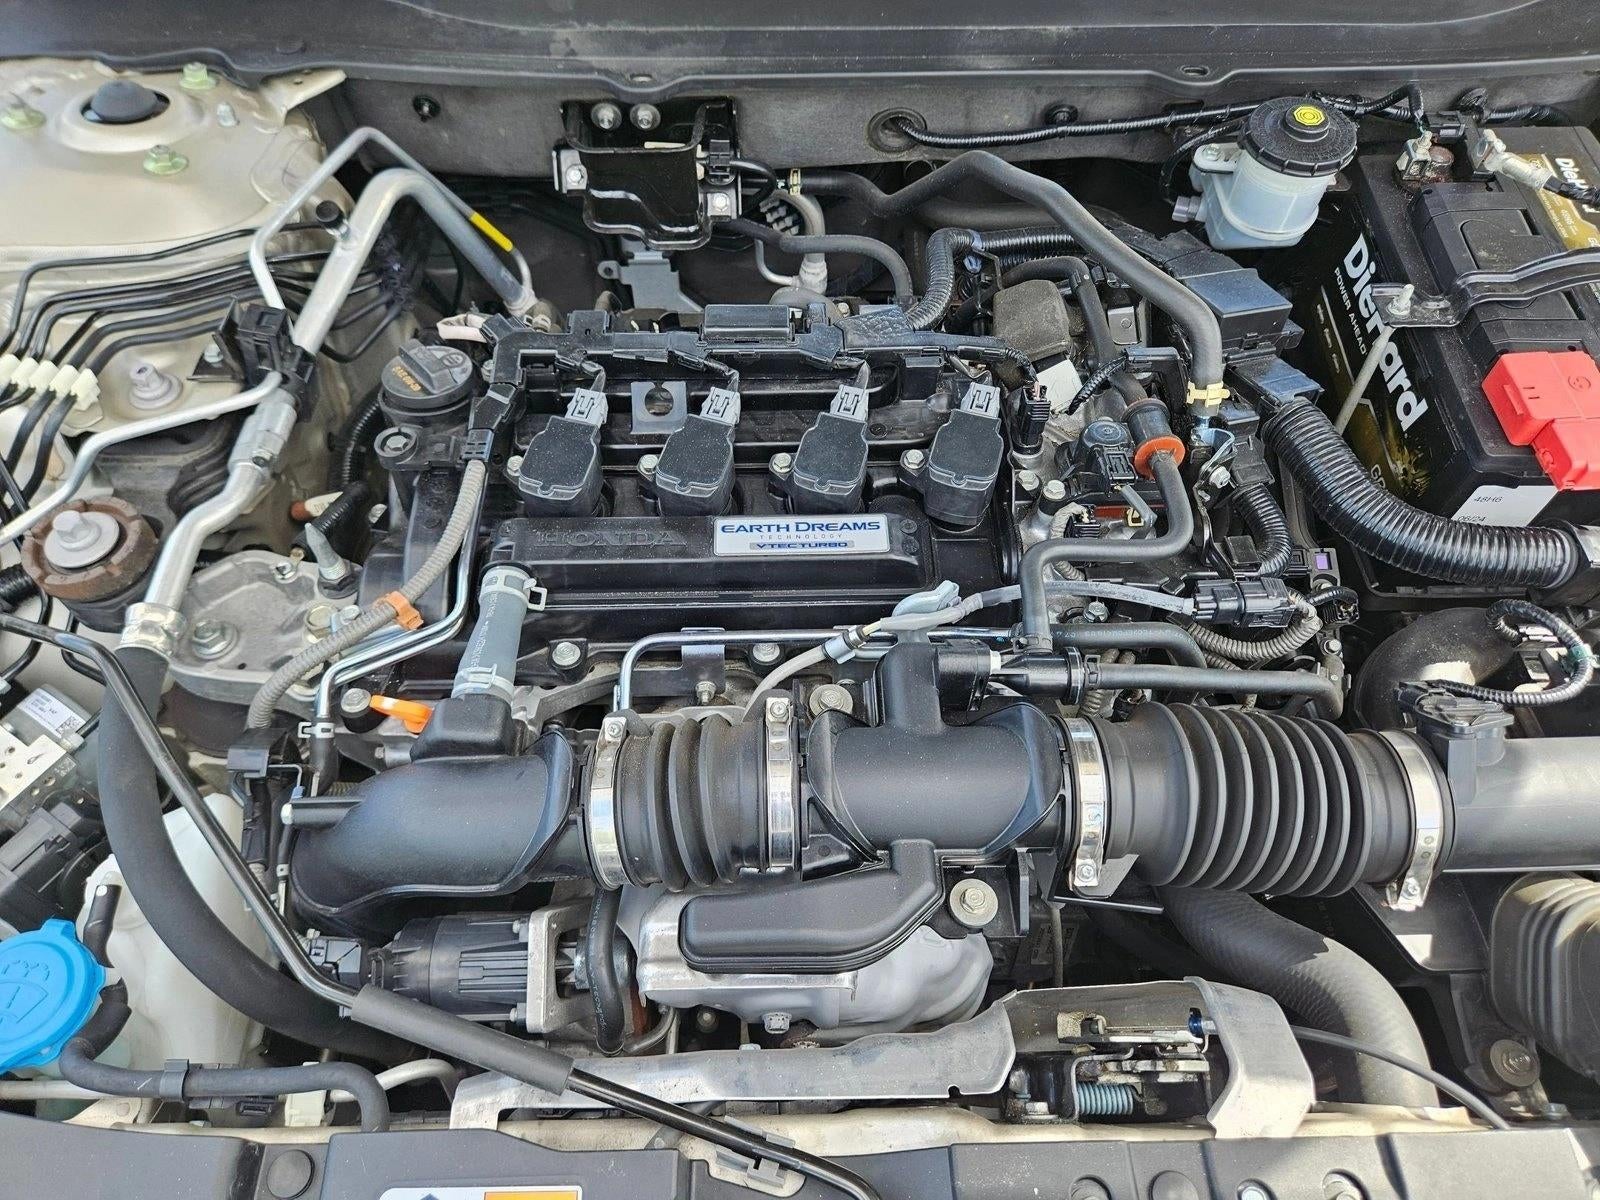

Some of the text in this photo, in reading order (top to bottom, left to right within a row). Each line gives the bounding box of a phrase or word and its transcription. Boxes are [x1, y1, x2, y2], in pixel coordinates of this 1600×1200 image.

[1334, 267, 1367, 355] POWER AHEAD
[721, 521, 881, 533] EARTH DREAMS
[532, 530, 688, 547] HONDA
